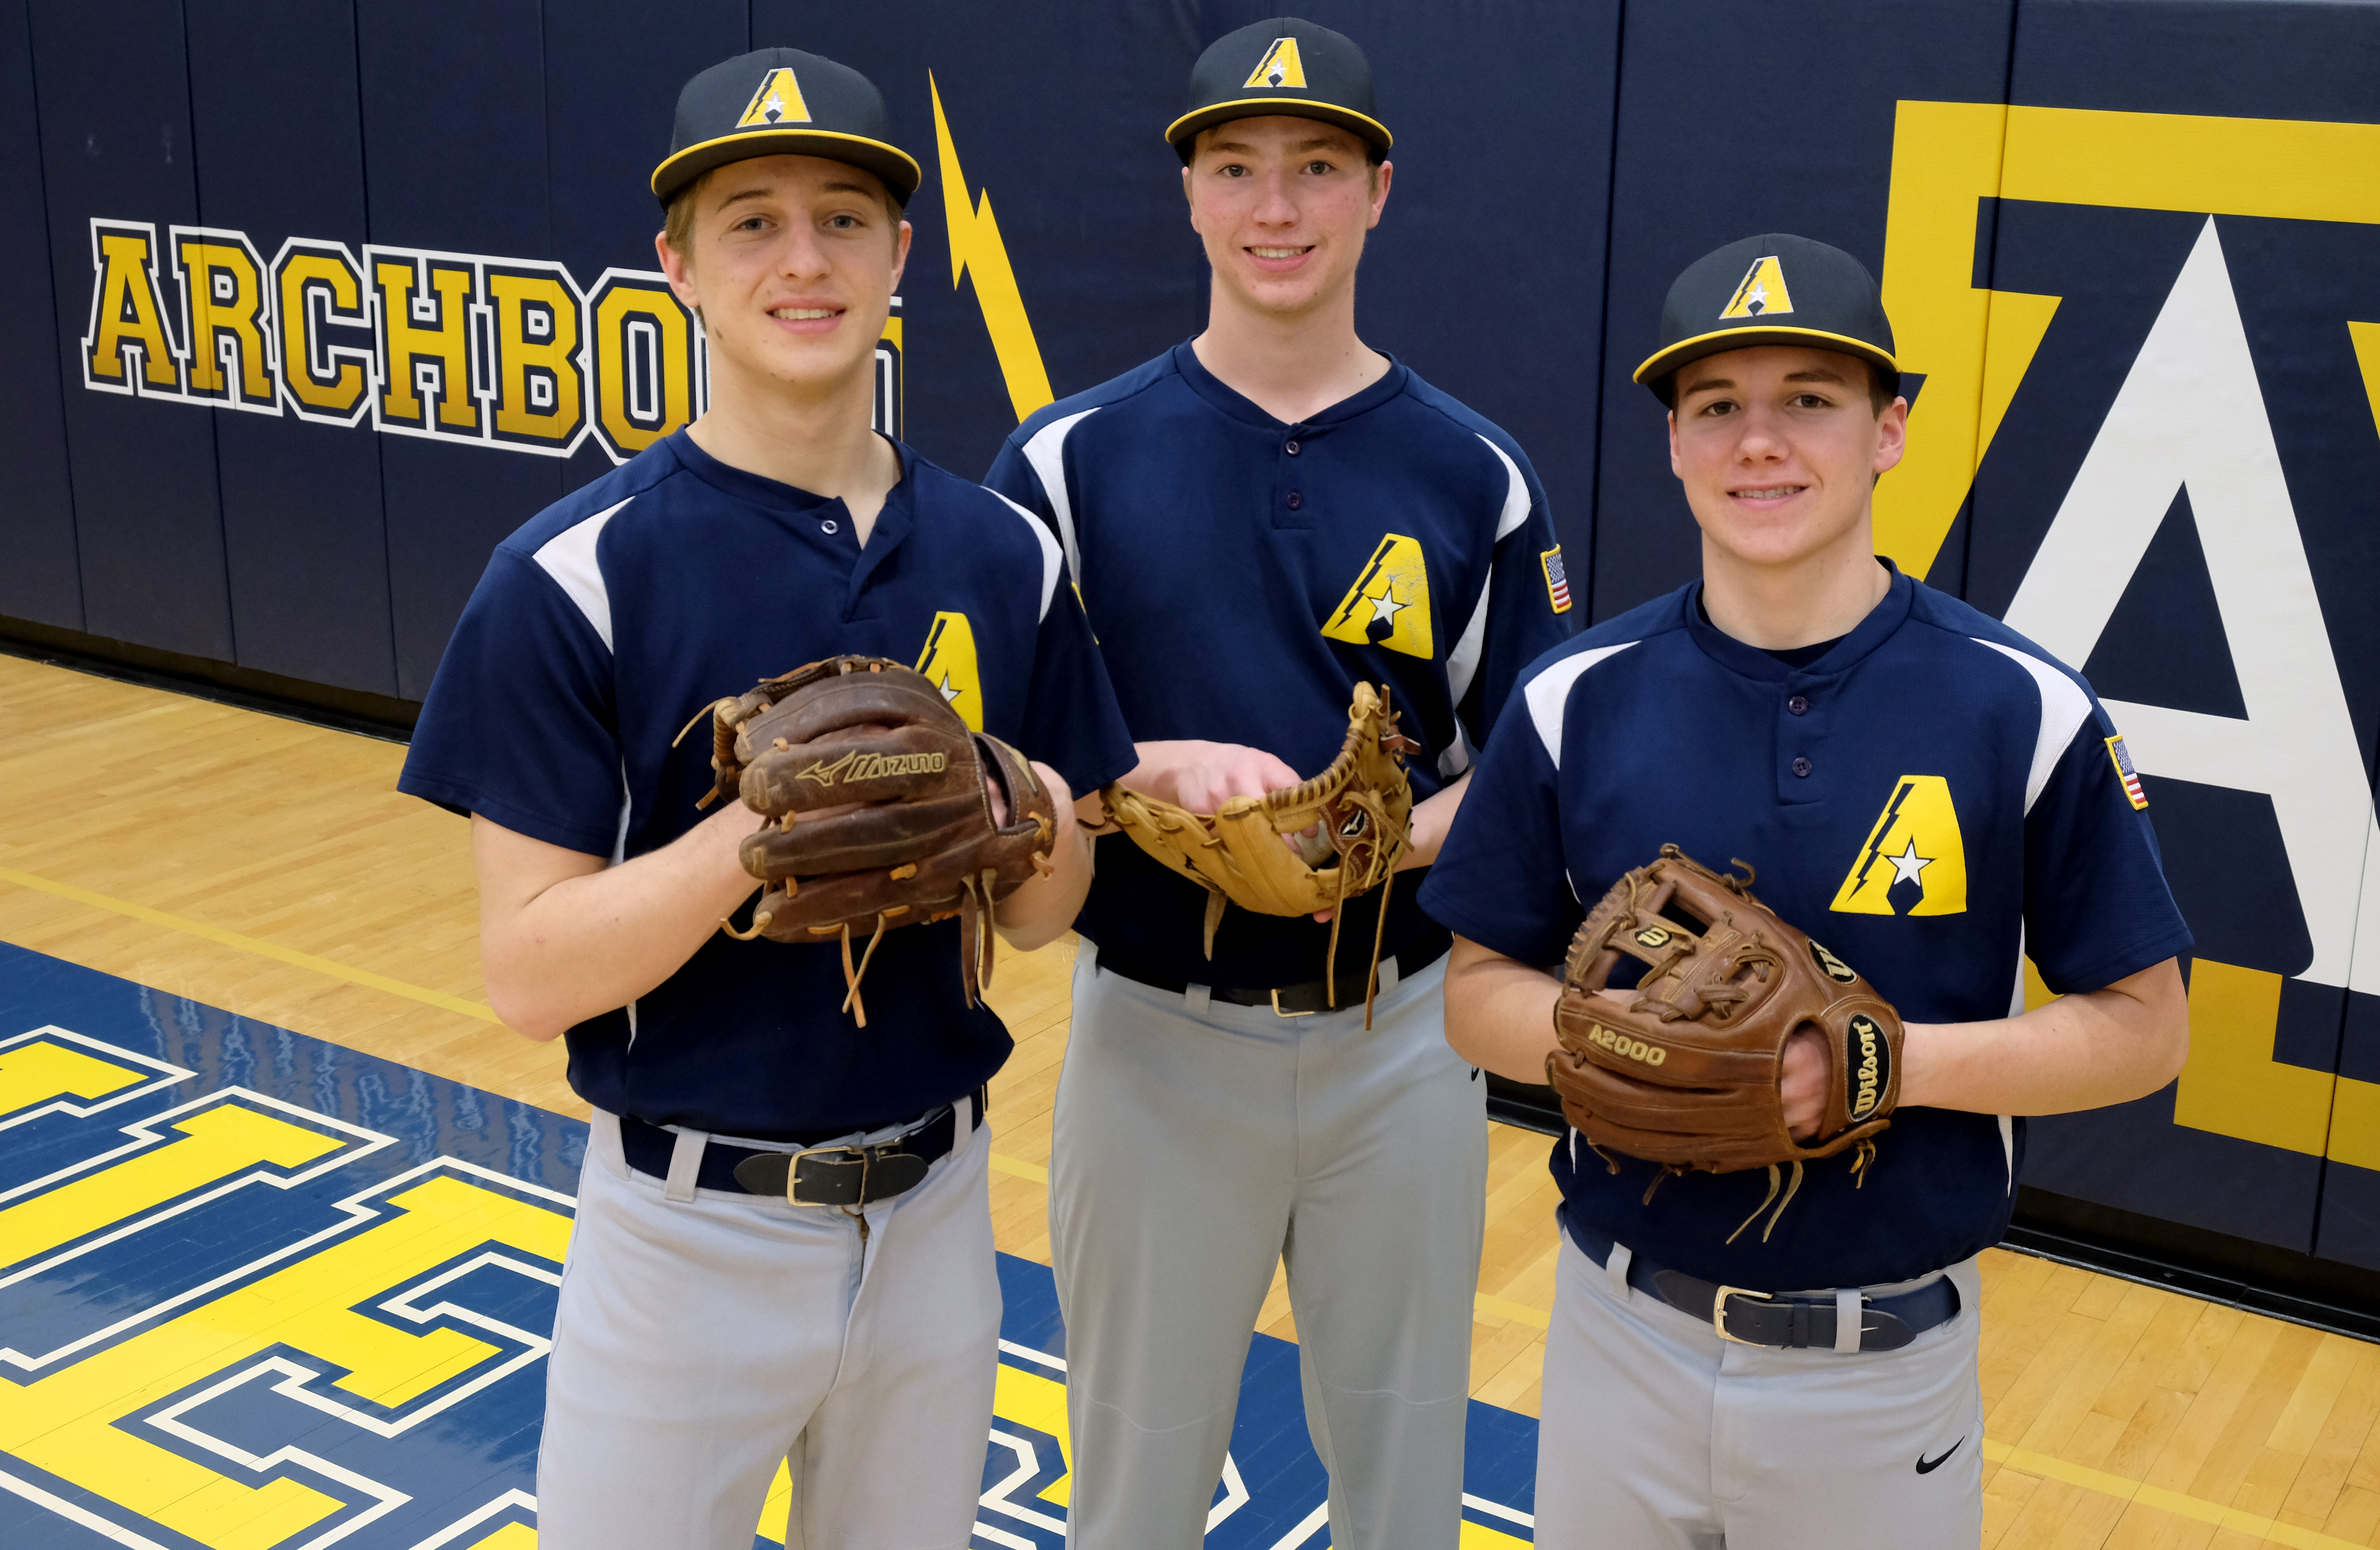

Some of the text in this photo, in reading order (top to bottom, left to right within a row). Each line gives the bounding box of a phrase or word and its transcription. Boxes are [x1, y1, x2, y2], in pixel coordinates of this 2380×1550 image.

[735, 67, 812, 128] A
[1242, 37, 1308, 88] A
[1718, 255, 1794, 319] A
[81, 218, 903, 465] ARCHBO
[1320, 533, 1434, 660] A
[1829, 775, 1967, 916] A
[1588, 1024, 1667, 1066] A2000
[1853, 1022, 1878, 1115] Wilson
